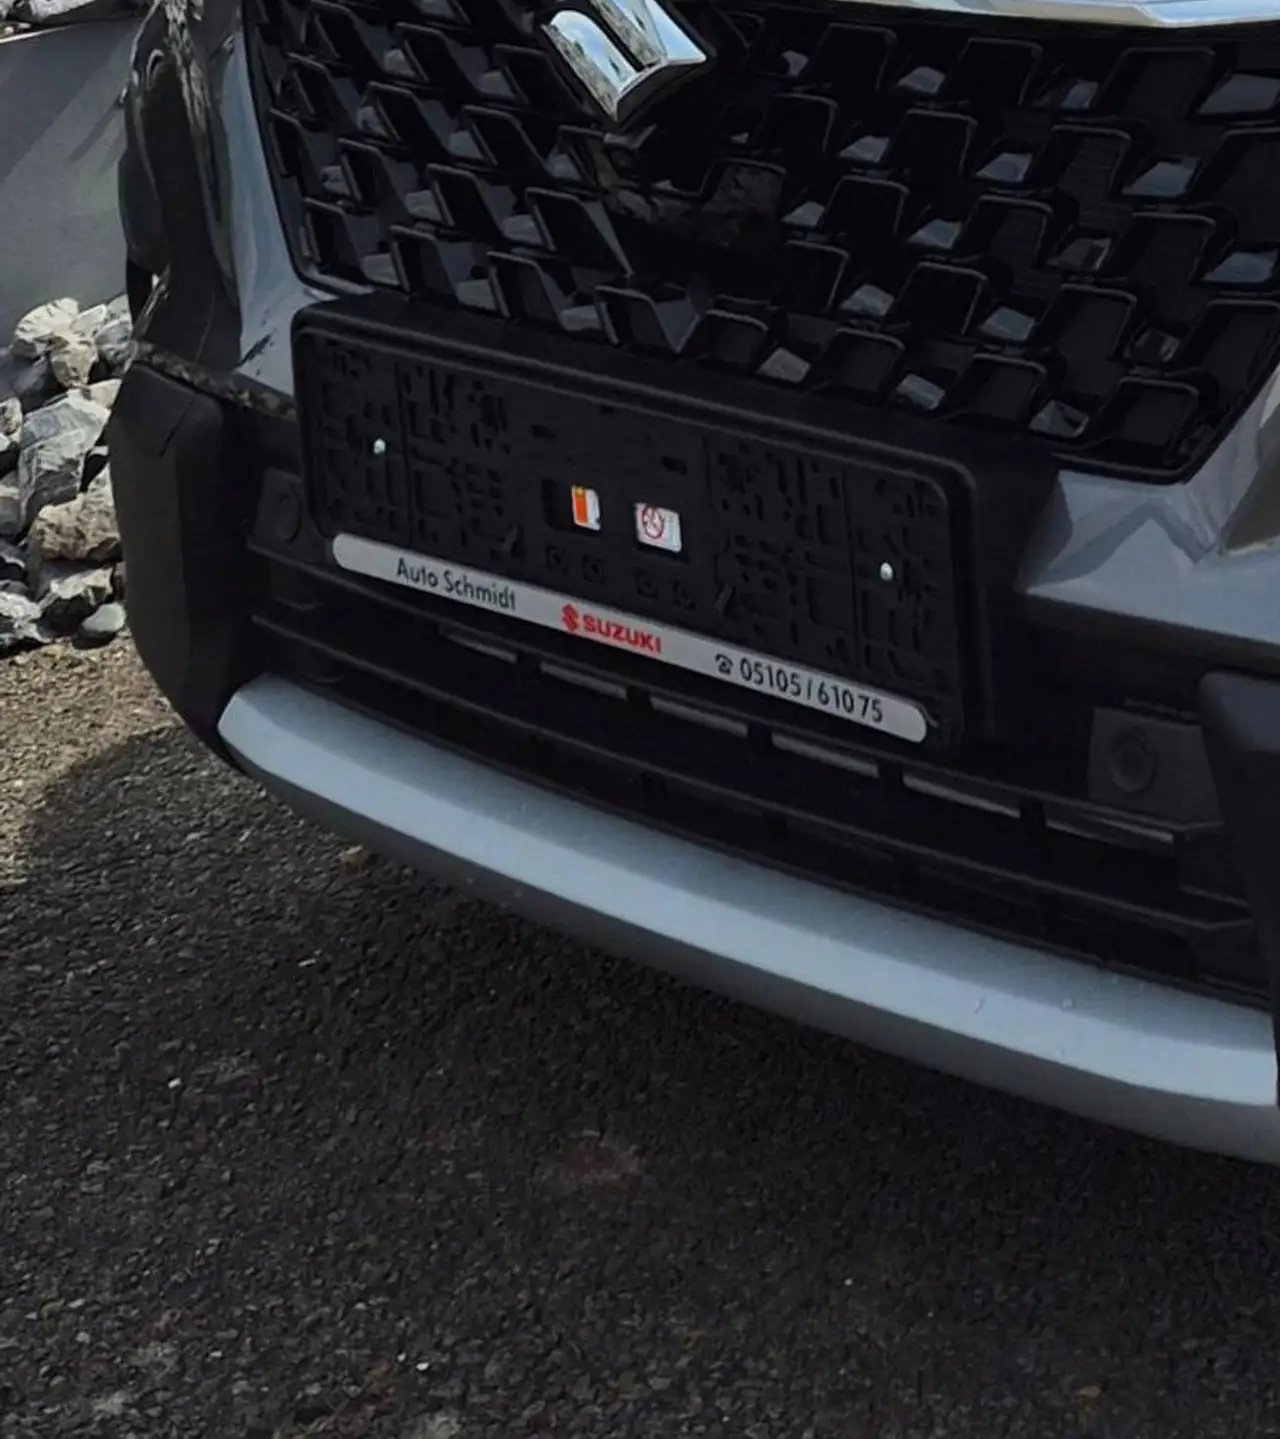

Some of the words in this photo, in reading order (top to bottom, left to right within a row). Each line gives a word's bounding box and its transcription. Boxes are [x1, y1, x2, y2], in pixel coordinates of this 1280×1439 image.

[395, 557, 439, 588] Auto
[443, 569, 517, 610] Schmidt
[581, 614, 662, 654] SUZUKI
